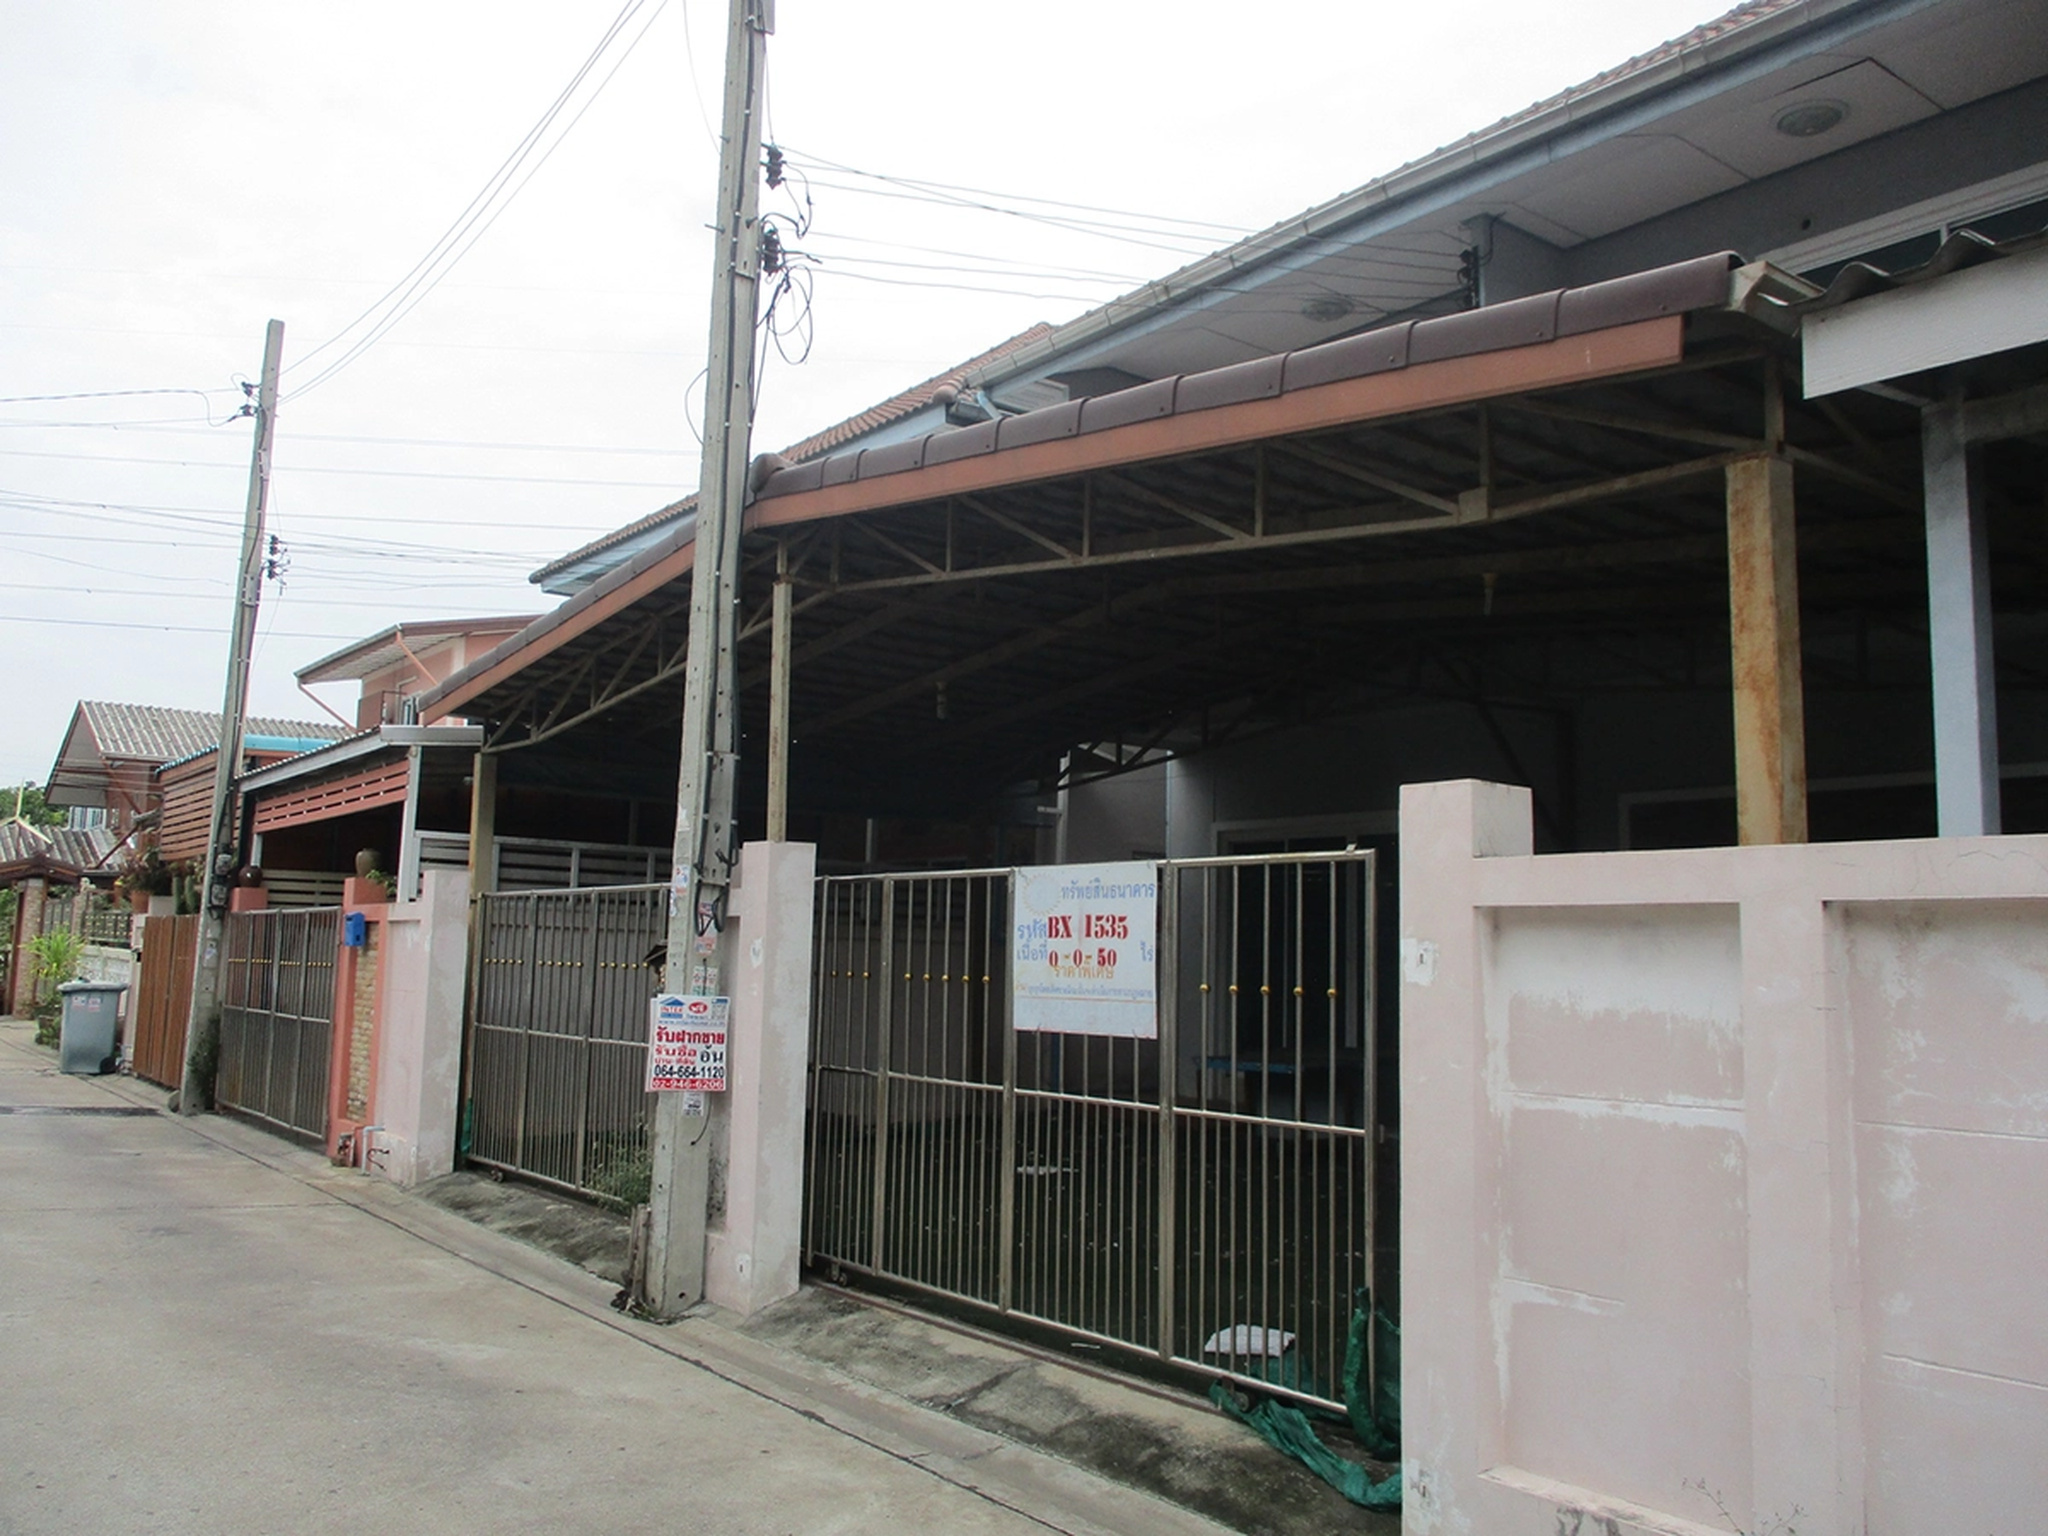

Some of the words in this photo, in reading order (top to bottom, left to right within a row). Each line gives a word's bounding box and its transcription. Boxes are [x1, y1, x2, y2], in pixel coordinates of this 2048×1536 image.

[1061, 877, 1156, 900] ทรัพย์สินธนาคาร
[1047, 915, 1073, 939] BX
[1083, 914, 1129, 940] 1535
[656, 1026, 725, 1045] รับฝากขาย
[654, 1065, 725, 1079] 064-664-1120
